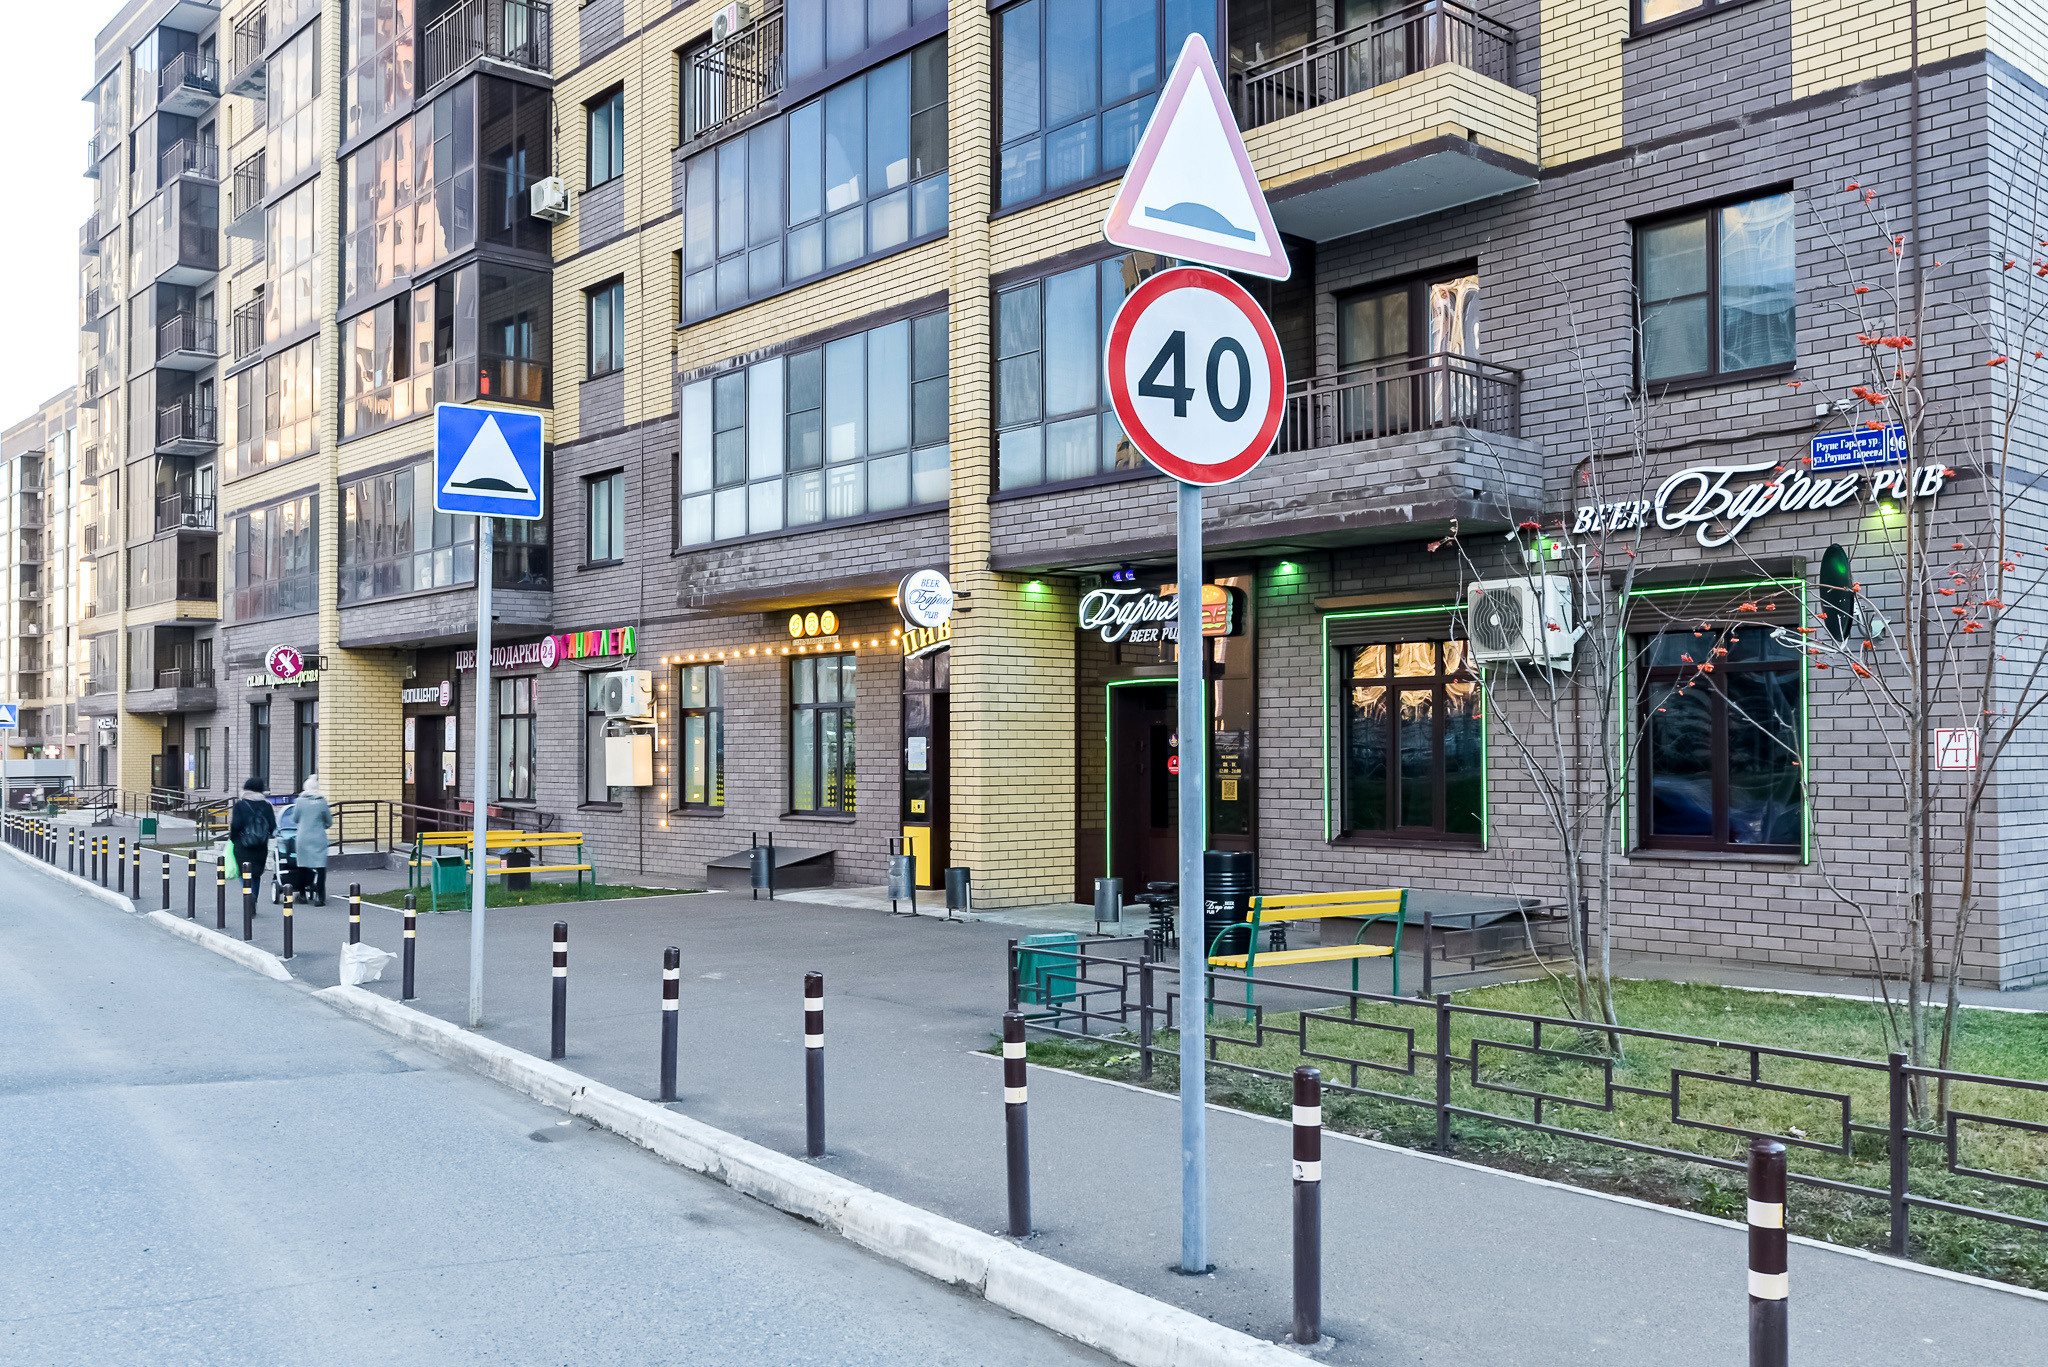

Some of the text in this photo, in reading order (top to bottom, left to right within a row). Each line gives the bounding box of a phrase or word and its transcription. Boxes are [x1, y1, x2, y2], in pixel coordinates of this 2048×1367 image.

[1138, 330, 1251, 423] 40
[1889, 435, 1907, 452] 96
[1572, 500, 1651, 534] BEER
[1869, 464, 1946, 502] PUB
[921, 578, 940, 588] BEER
[924, 610, 939, 619] PUB
[1128, 627, 1179, 643] BEER PU
[491, 643, 541, 669] ПОДАРКИ
[543, 645, 553, 658] 24
